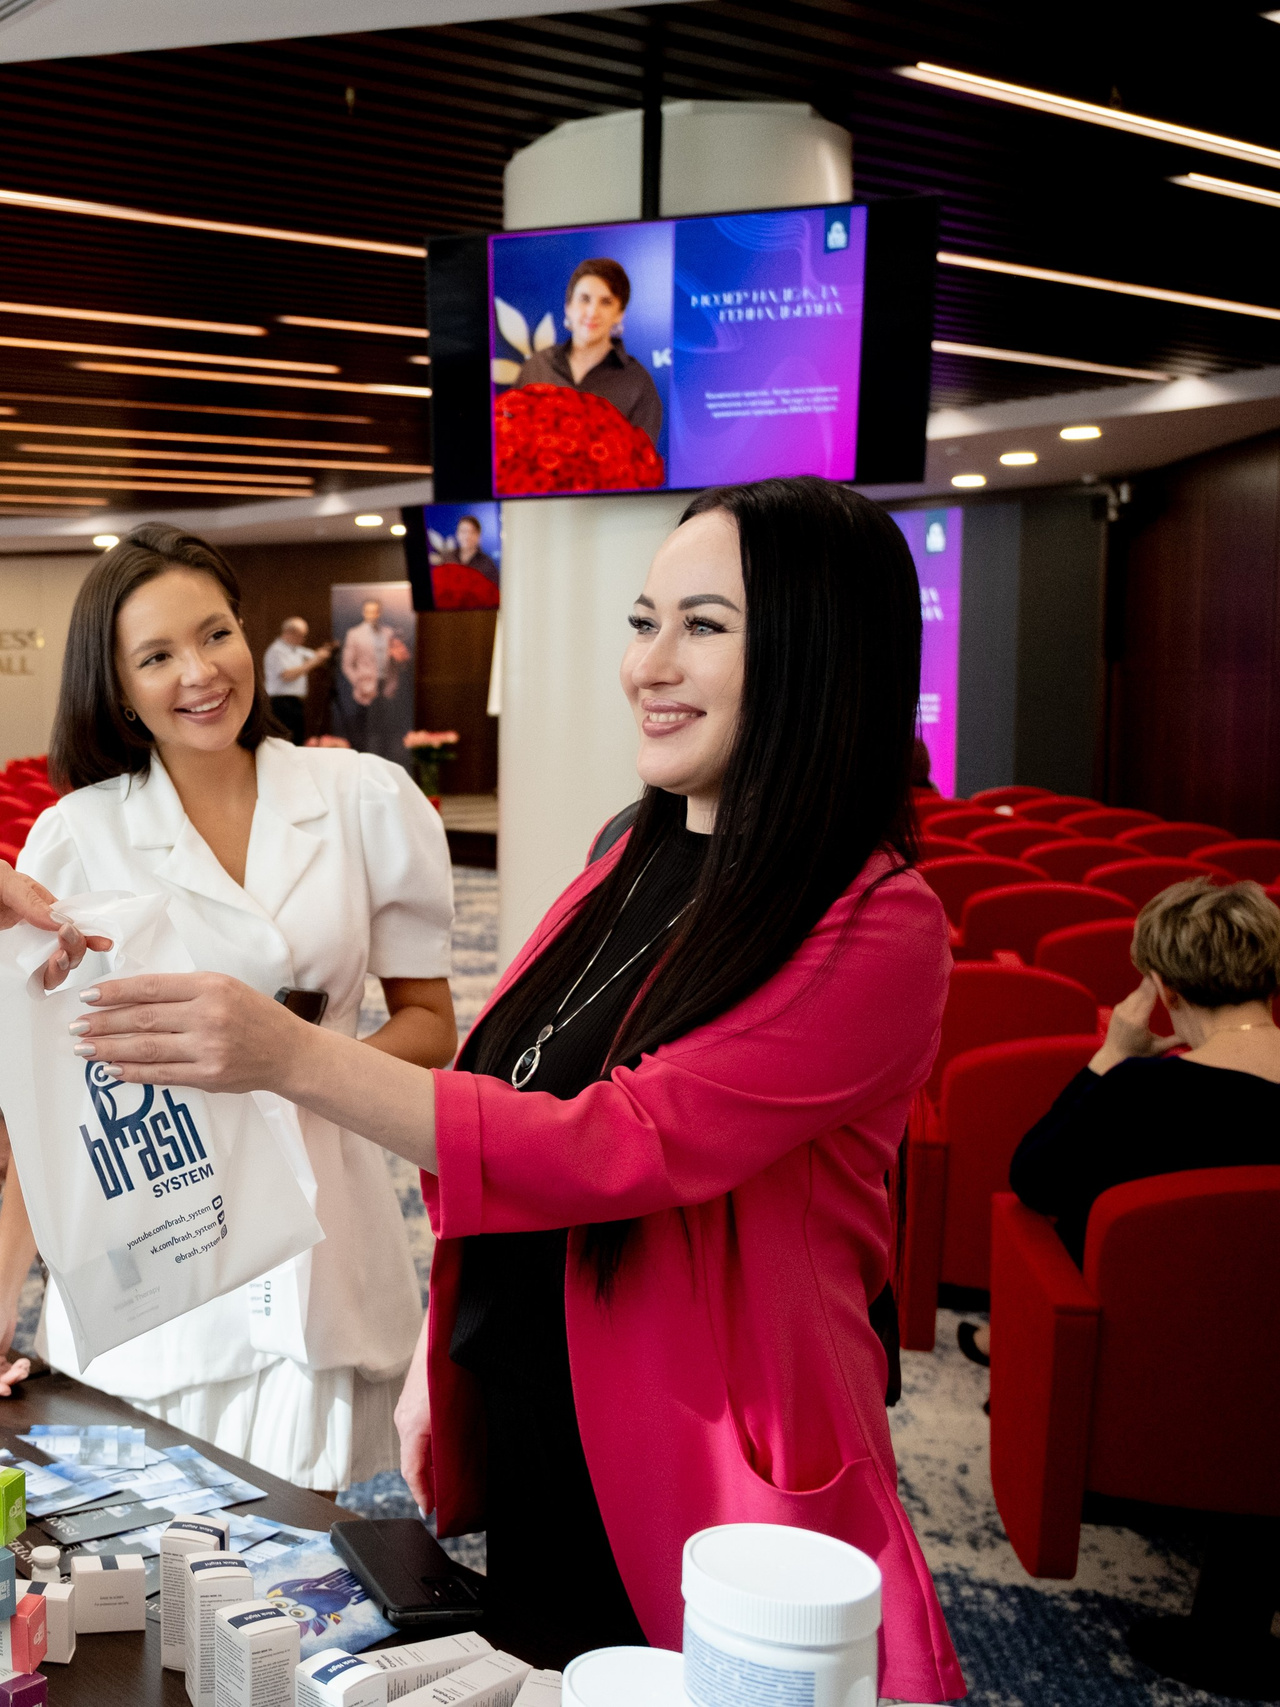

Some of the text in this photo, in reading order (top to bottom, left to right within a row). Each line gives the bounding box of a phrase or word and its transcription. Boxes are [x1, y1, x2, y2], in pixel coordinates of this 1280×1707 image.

[152, 1163, 215, 1198] SYSTEM
[127, 1205, 212, 1250] youtube.com/brash_system
[150, 1221, 217, 1255] vk.com/brash_system
[174, 1237, 221, 1264] @brash_system
